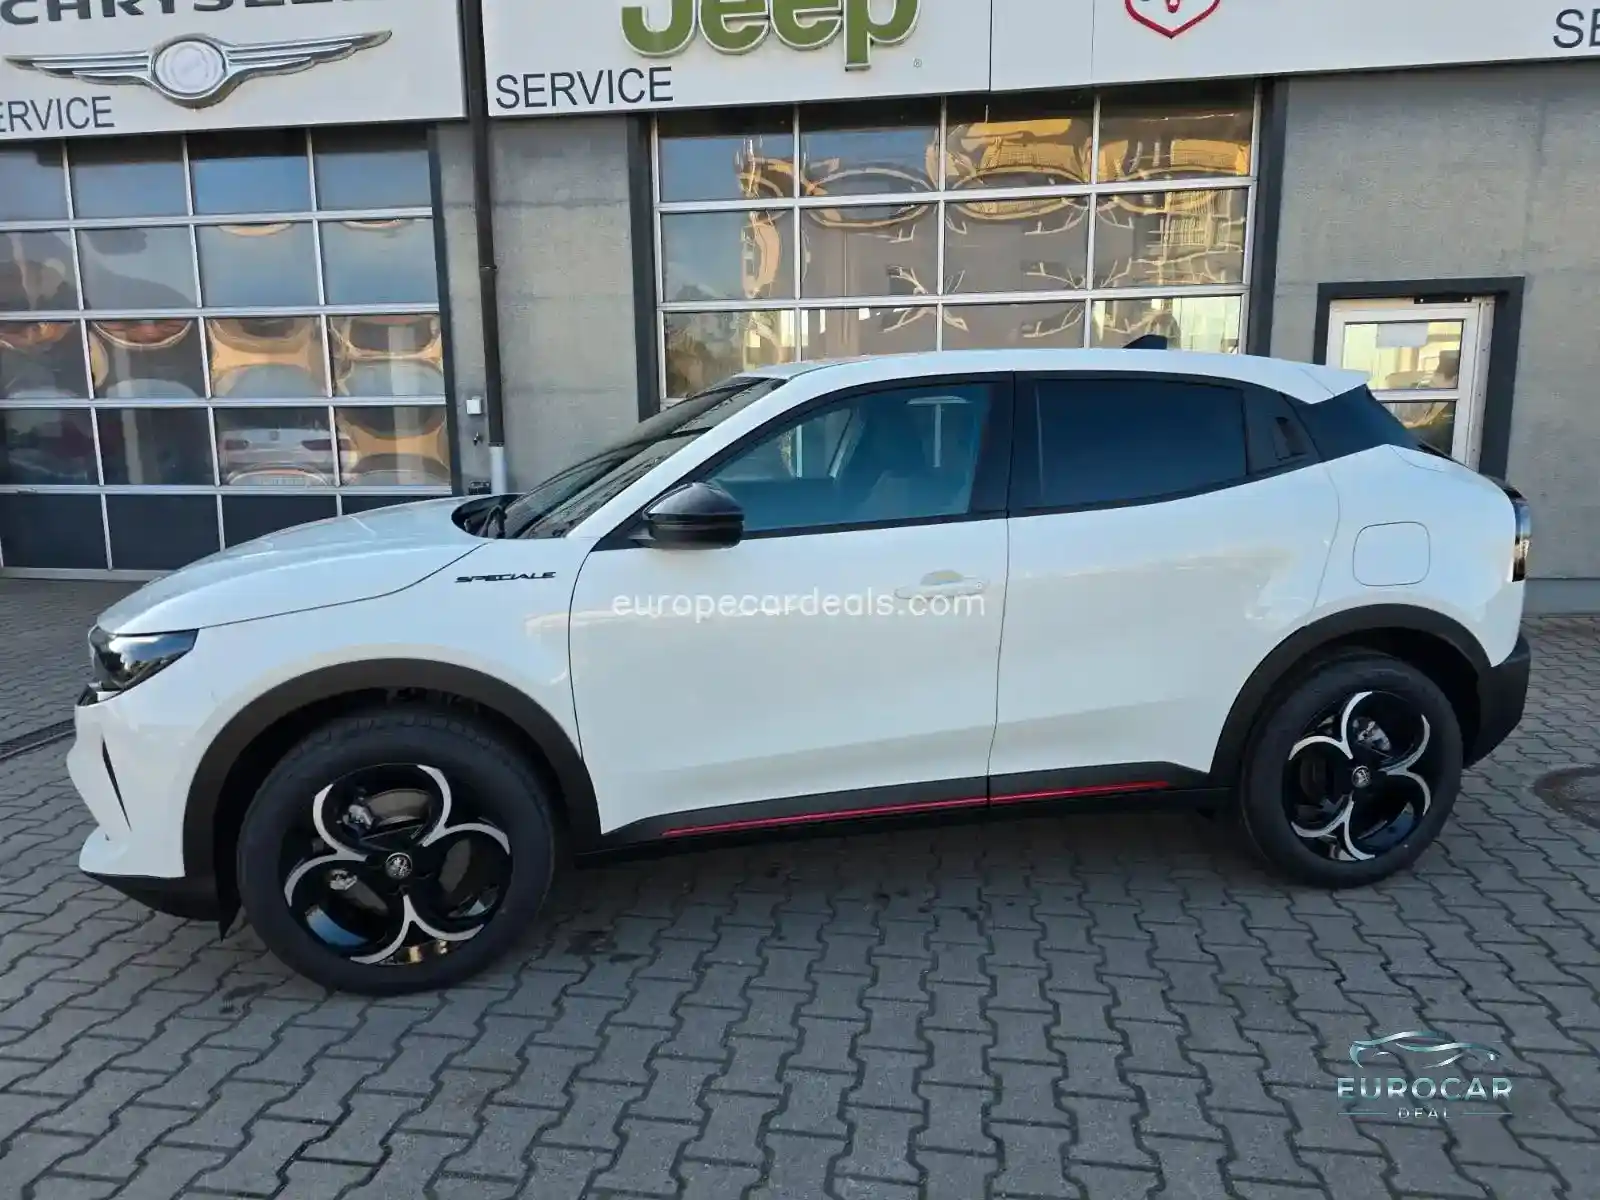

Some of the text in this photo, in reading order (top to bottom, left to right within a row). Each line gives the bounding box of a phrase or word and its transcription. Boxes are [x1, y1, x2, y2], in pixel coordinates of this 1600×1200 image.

[621, 0, 921, 71] Jeep
[496, 66, 674, 109] SERVICE
[455, 571, 557, 583] SPECIALE
